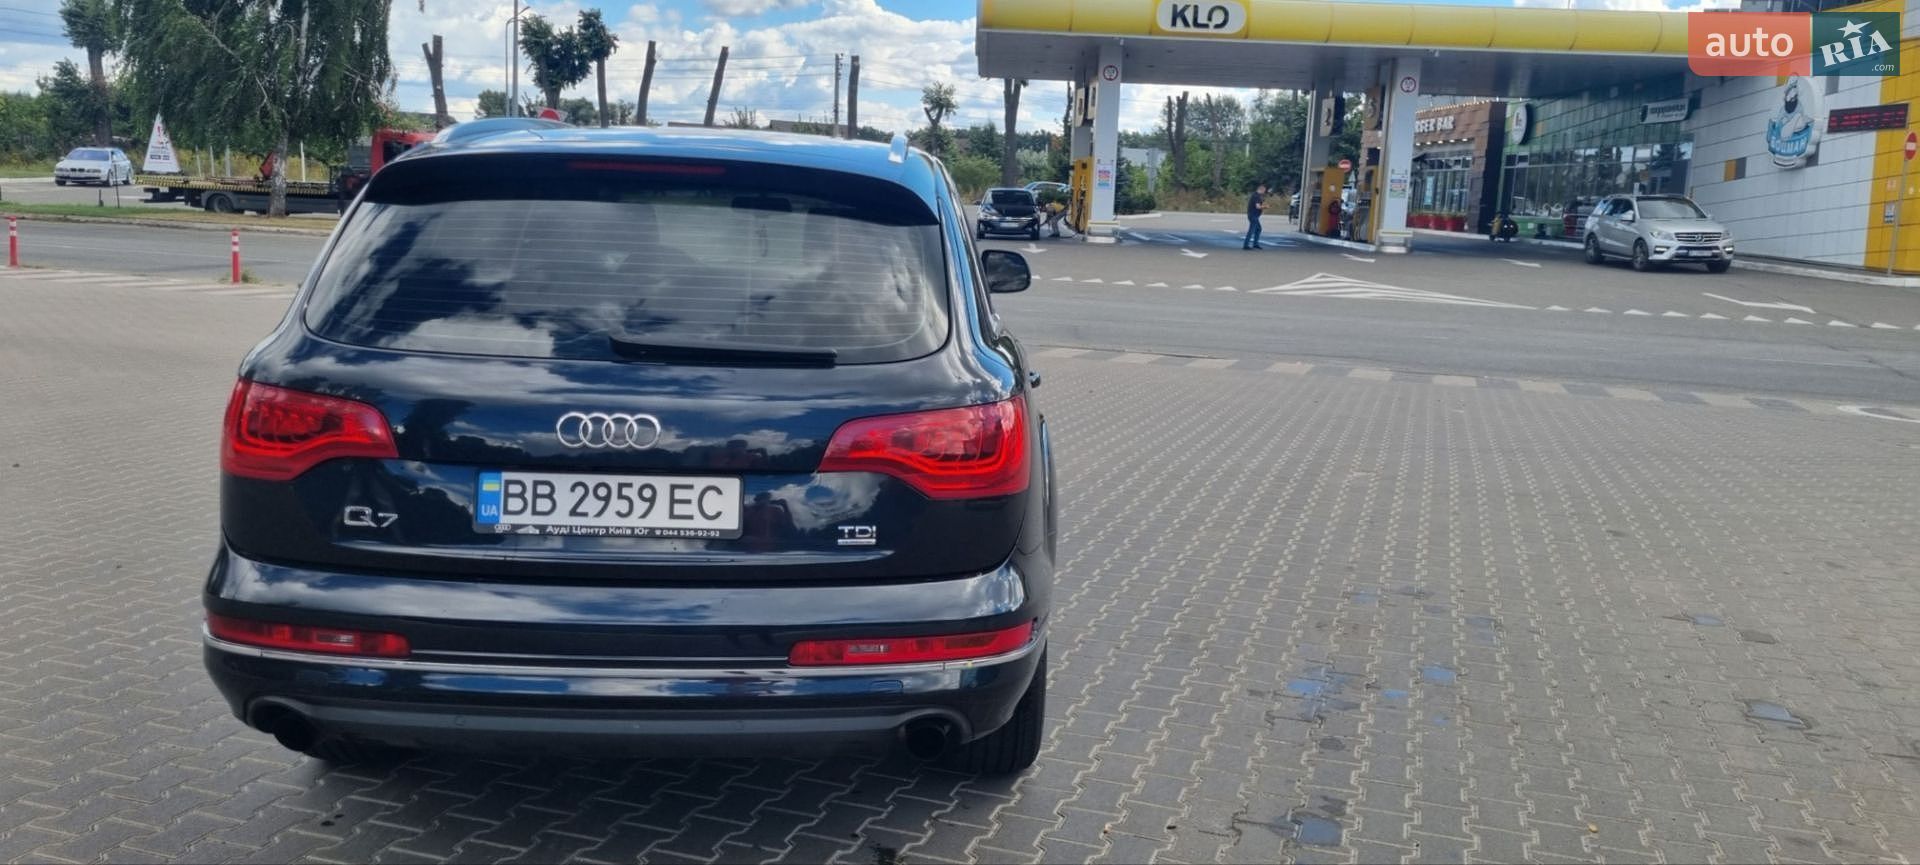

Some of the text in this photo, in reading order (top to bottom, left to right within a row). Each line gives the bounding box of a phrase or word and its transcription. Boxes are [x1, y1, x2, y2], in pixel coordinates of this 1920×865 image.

[1170, 3, 1230, 30] KLO
[1414, 115, 1455, 133] RGER BAR
[502, 479, 724, 521] BB 2959 EC
[343, 505, 399, 528] Q7
[481, 503, 498, 517] UA
[545, 525, 570, 536] Ауді
[572, 526, 606, 536] Центр
[608, 527, 632, 535] Київ
[634, 528, 650, 536] Юг
[837, 525, 877, 538] TDI
